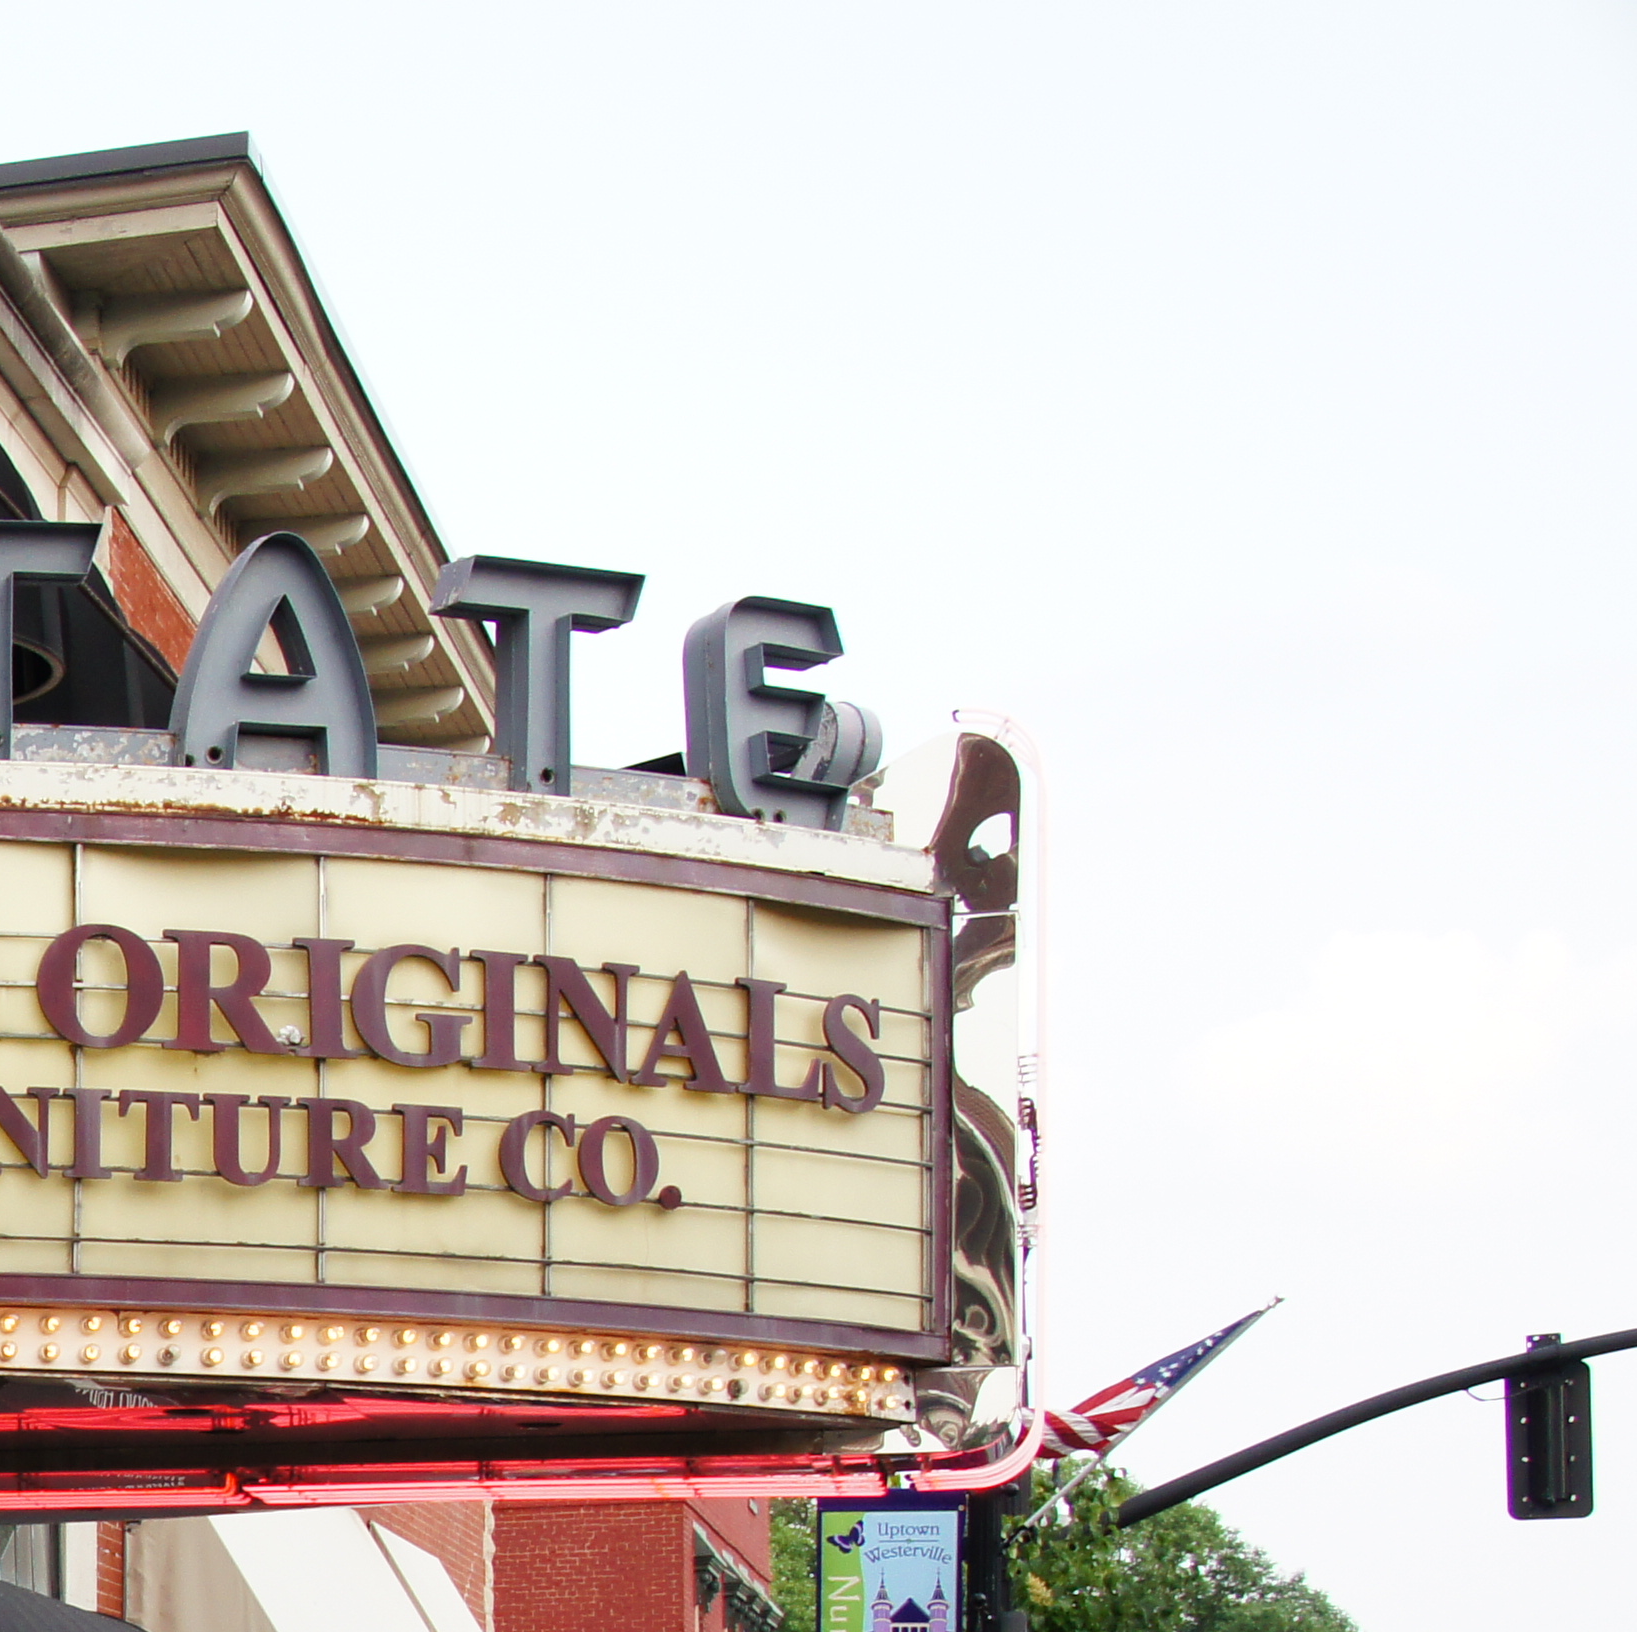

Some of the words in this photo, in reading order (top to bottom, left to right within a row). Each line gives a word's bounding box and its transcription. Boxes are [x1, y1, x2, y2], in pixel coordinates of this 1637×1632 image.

[35, 922, 887, 1114] ORIGINALS
[499, 1110, 686, 1210] CO.
[864, 1544, 952, 1565] Westerville
[877, 1521, 940, 1540] Uptown
